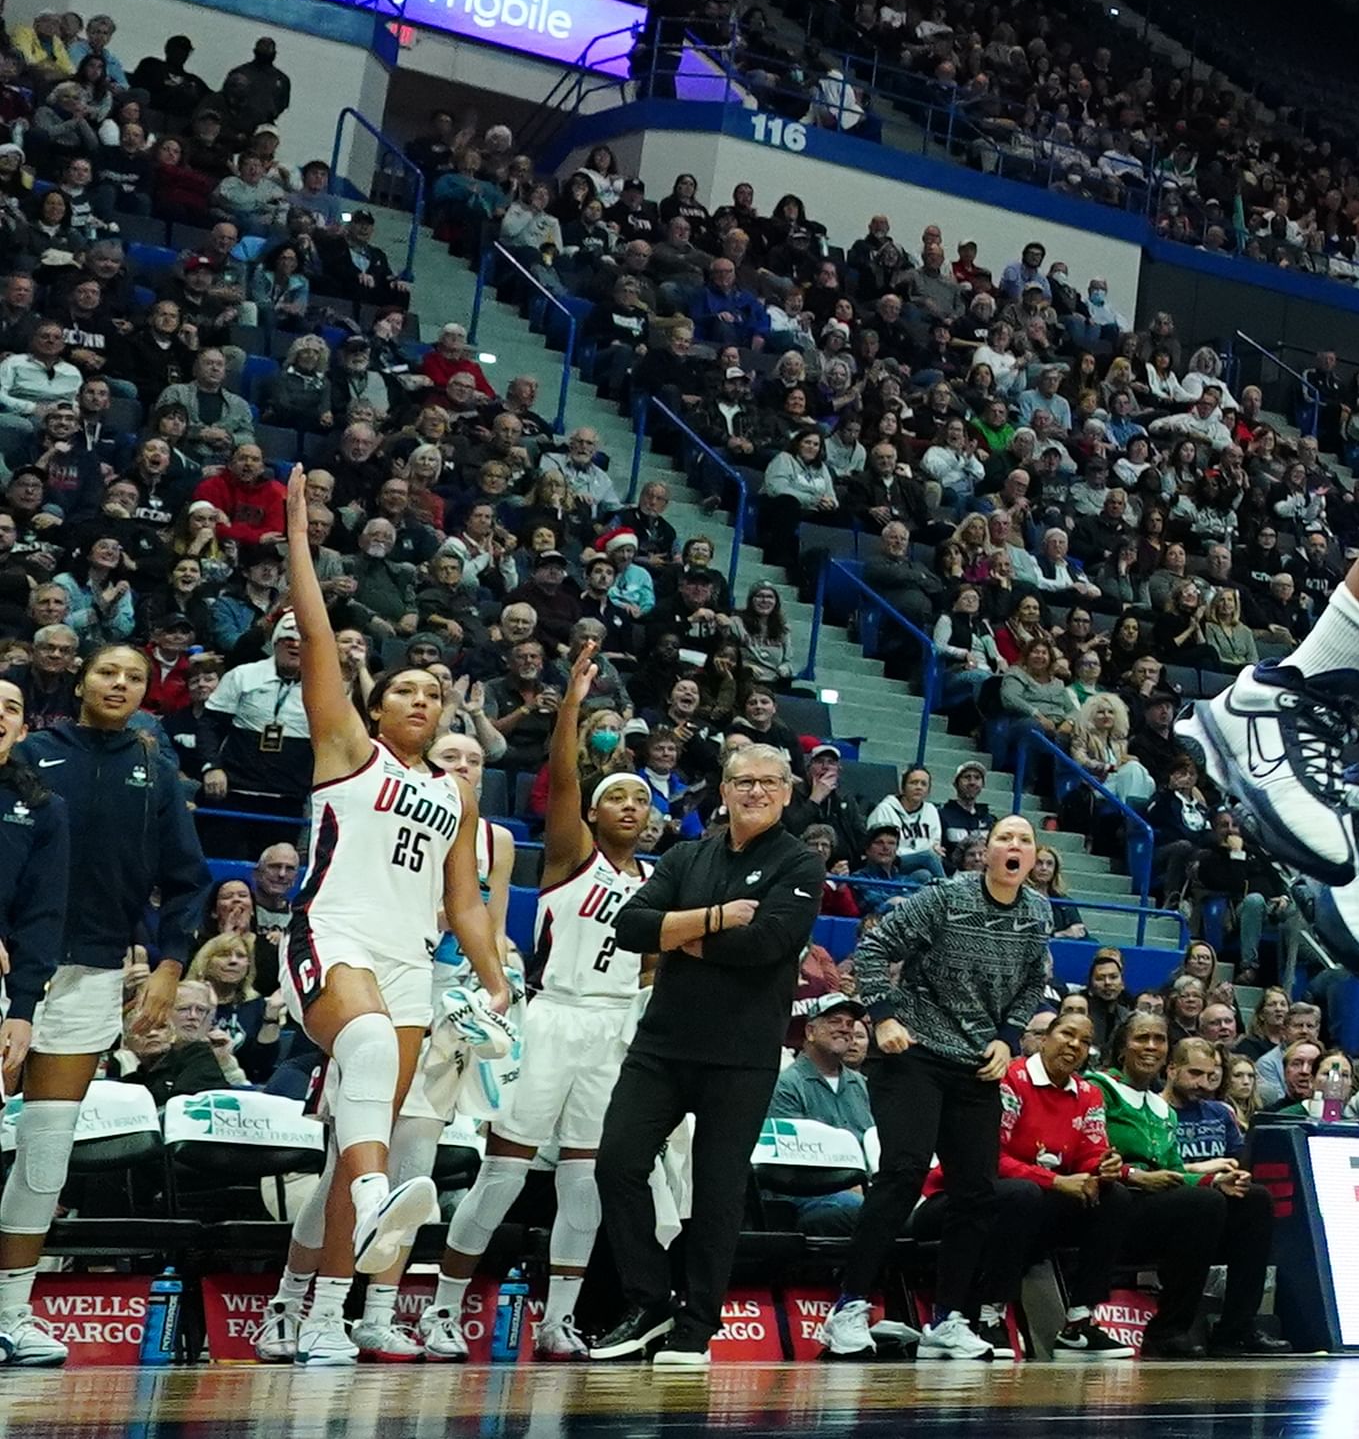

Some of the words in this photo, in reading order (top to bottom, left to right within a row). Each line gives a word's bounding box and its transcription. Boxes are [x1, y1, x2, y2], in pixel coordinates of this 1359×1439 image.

[751, 113, 807, 151] 116
[392, 827, 431, 873] 25
[214, 1112, 272, 1129] Select
[778, 1136, 824, 1153] Select
[43, 1296, 146, 1317] WELLS
[51, 1323, 145, 1344] FARGO
